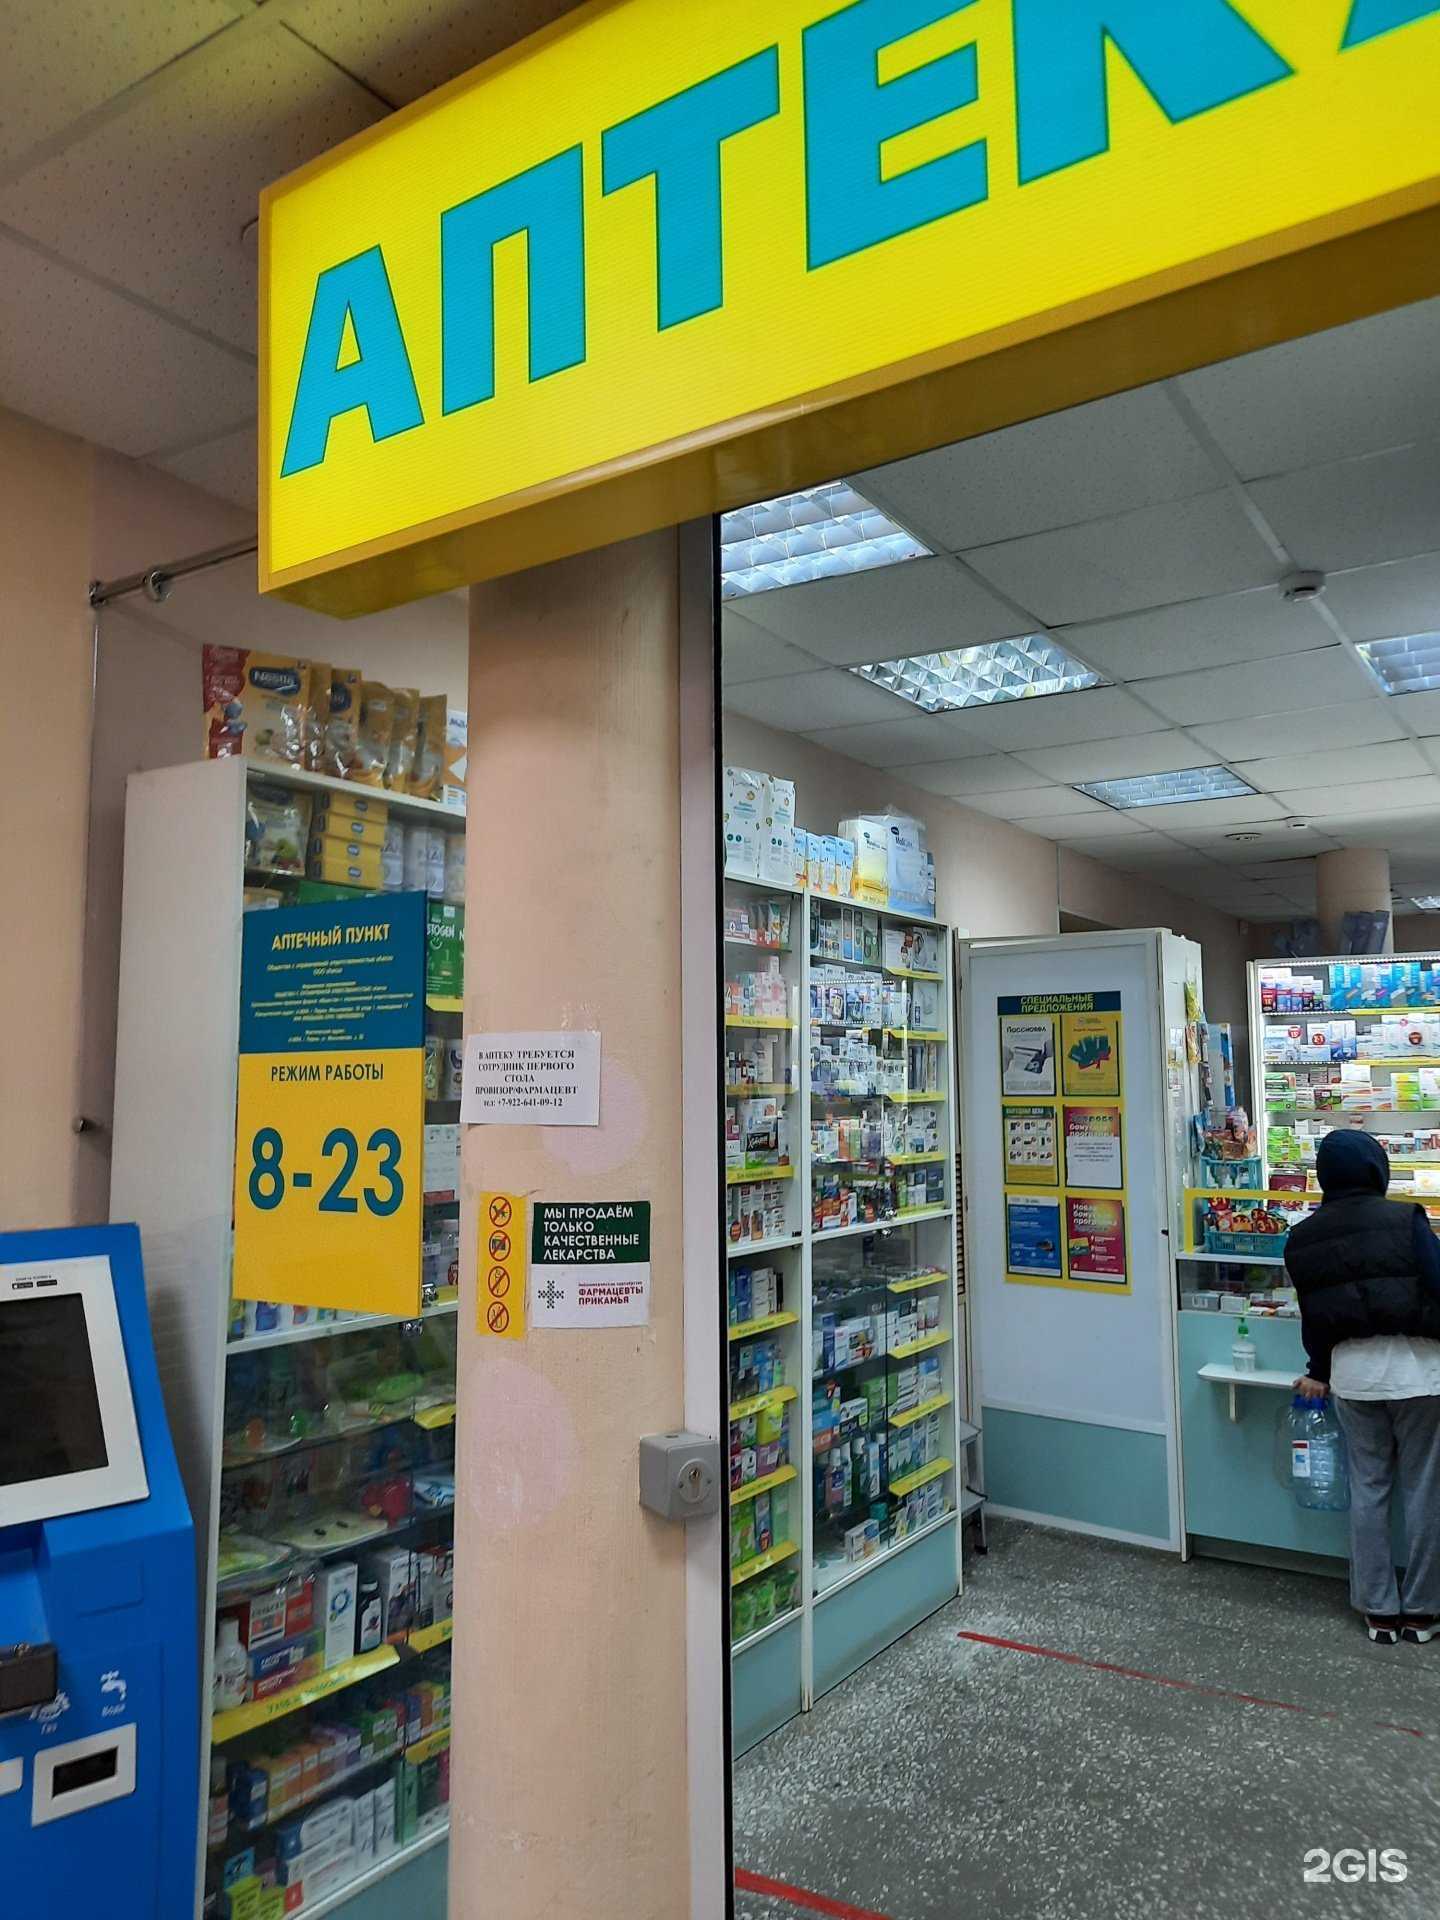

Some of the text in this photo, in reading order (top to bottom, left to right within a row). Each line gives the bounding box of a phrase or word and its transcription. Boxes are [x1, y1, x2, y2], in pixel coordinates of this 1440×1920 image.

[281, 0, 1440, 478] АПТЕК
[272, 923, 391, 950] АПТЕЧНЫЙ ПУНКТ
[1020, 993, 1094, 1005] СПЕЦИАЛЬНЫЕ
[1021, 1002, 1094, 1013] ПРЕДЛОЖЕНИЯ
[479, 1049, 575, 1060] В АПТЕКУ ТРЕБУЕТСЯ
[271, 1062, 385, 1081] РЕЖИМ РАБОТЫ
[478, 1061, 575, 1072] СОТРУДНИК ПЕРВОГО
[504, 1074, 535, 1083] СТОЛА
[475, 1085, 579, 1096] ПРОВИЗОР/ФАРМАЦЕВТ
[248, 1126, 405, 1217] 8-23
[543, 1205, 634, 1219] МЫ ПРОДАЁМ
[543, 1221, 594, 1233] ТОЛЬКО
[543, 1234, 640, 1247] КАЧЕСТВЕННЫЕ
[543, 1249, 616, 1261] ЛЕКАРСТВА
[578, 1286, 644, 1297] ФАРМАЦЕВТЫ
[578, 1296, 630, 1306] ПРИКАМЬЯ
